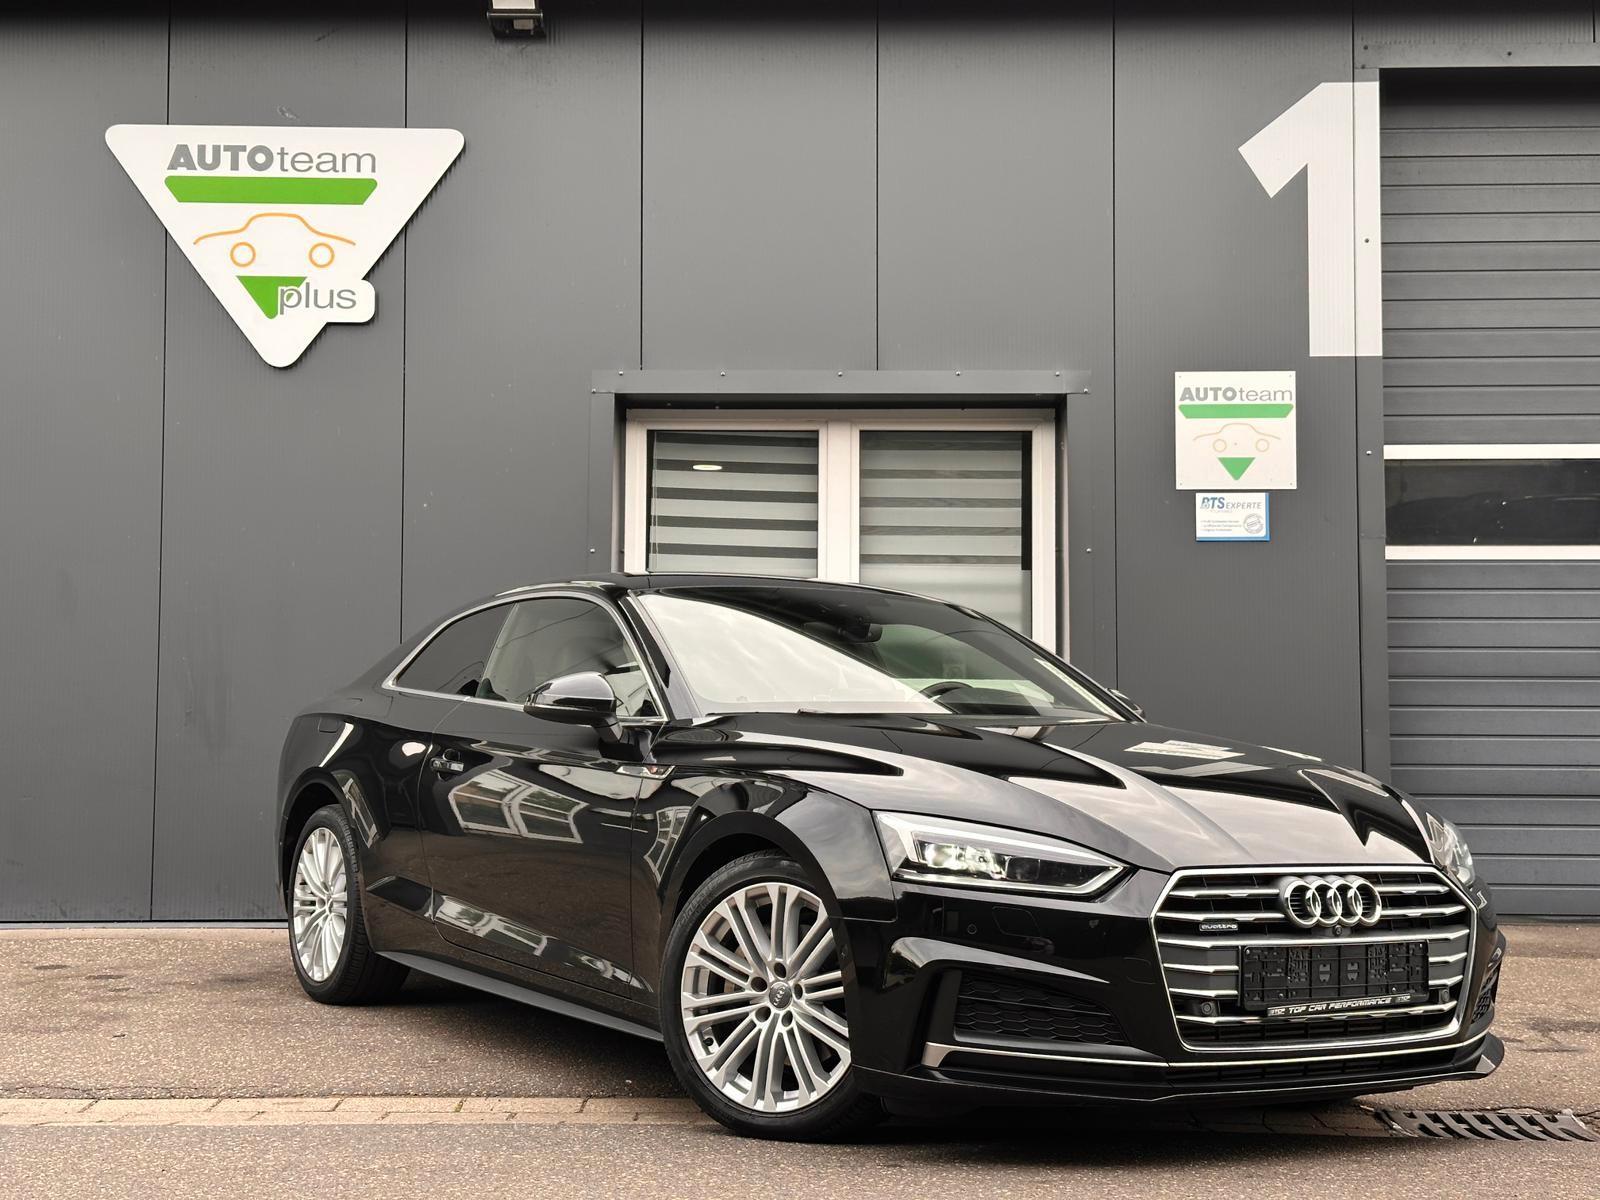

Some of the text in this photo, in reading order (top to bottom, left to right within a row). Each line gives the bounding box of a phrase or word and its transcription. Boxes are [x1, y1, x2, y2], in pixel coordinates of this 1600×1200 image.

[166, 143, 377, 173] AUTOteam
[1238, 81, 1383, 357] 1
[279, 282, 358, 315] plus
[1179, 386, 1293, 402] AUTOteam
[1289, 1006, 1307, 1014] TOP
[1309, 1003, 1328, 1011] CAR
[1329, 998, 1392, 1009] PERFORMANCE
